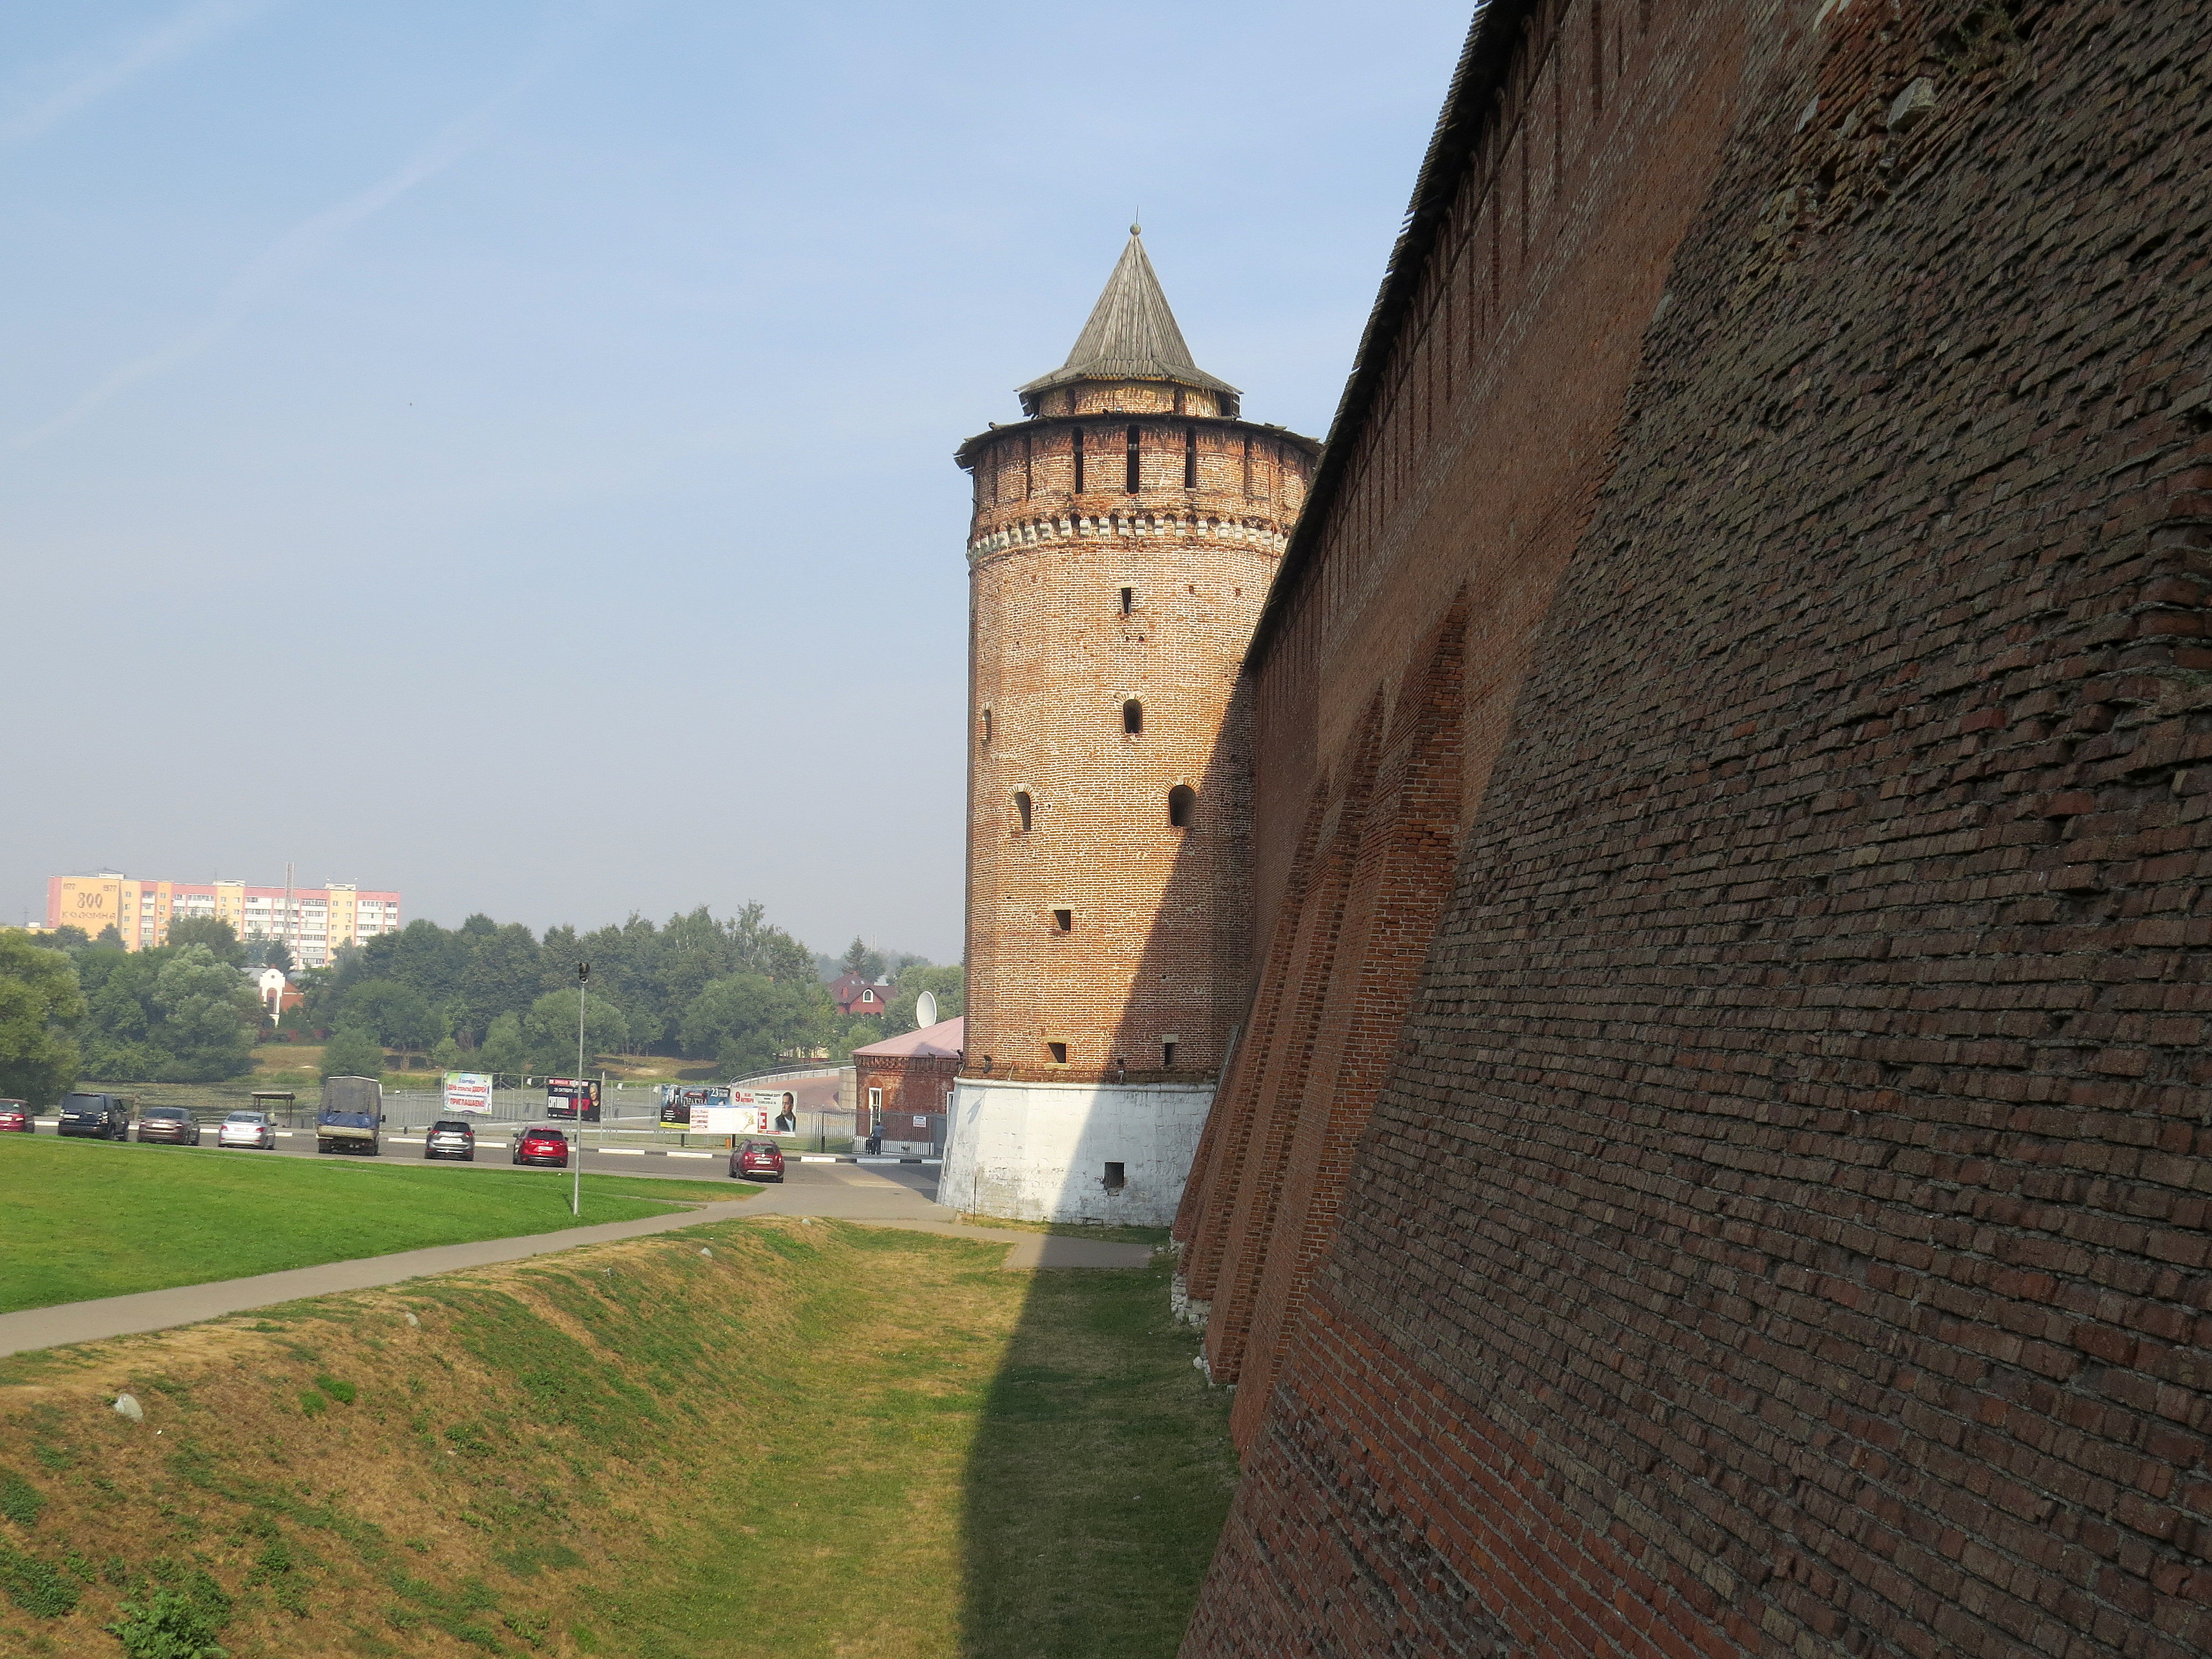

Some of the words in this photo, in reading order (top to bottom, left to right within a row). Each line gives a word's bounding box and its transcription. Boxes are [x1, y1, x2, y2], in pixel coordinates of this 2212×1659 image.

[77, 893, 103, 909] 800
[710, 1088, 719, 1097] 23
[735, 1091, 740, 1102] 9
